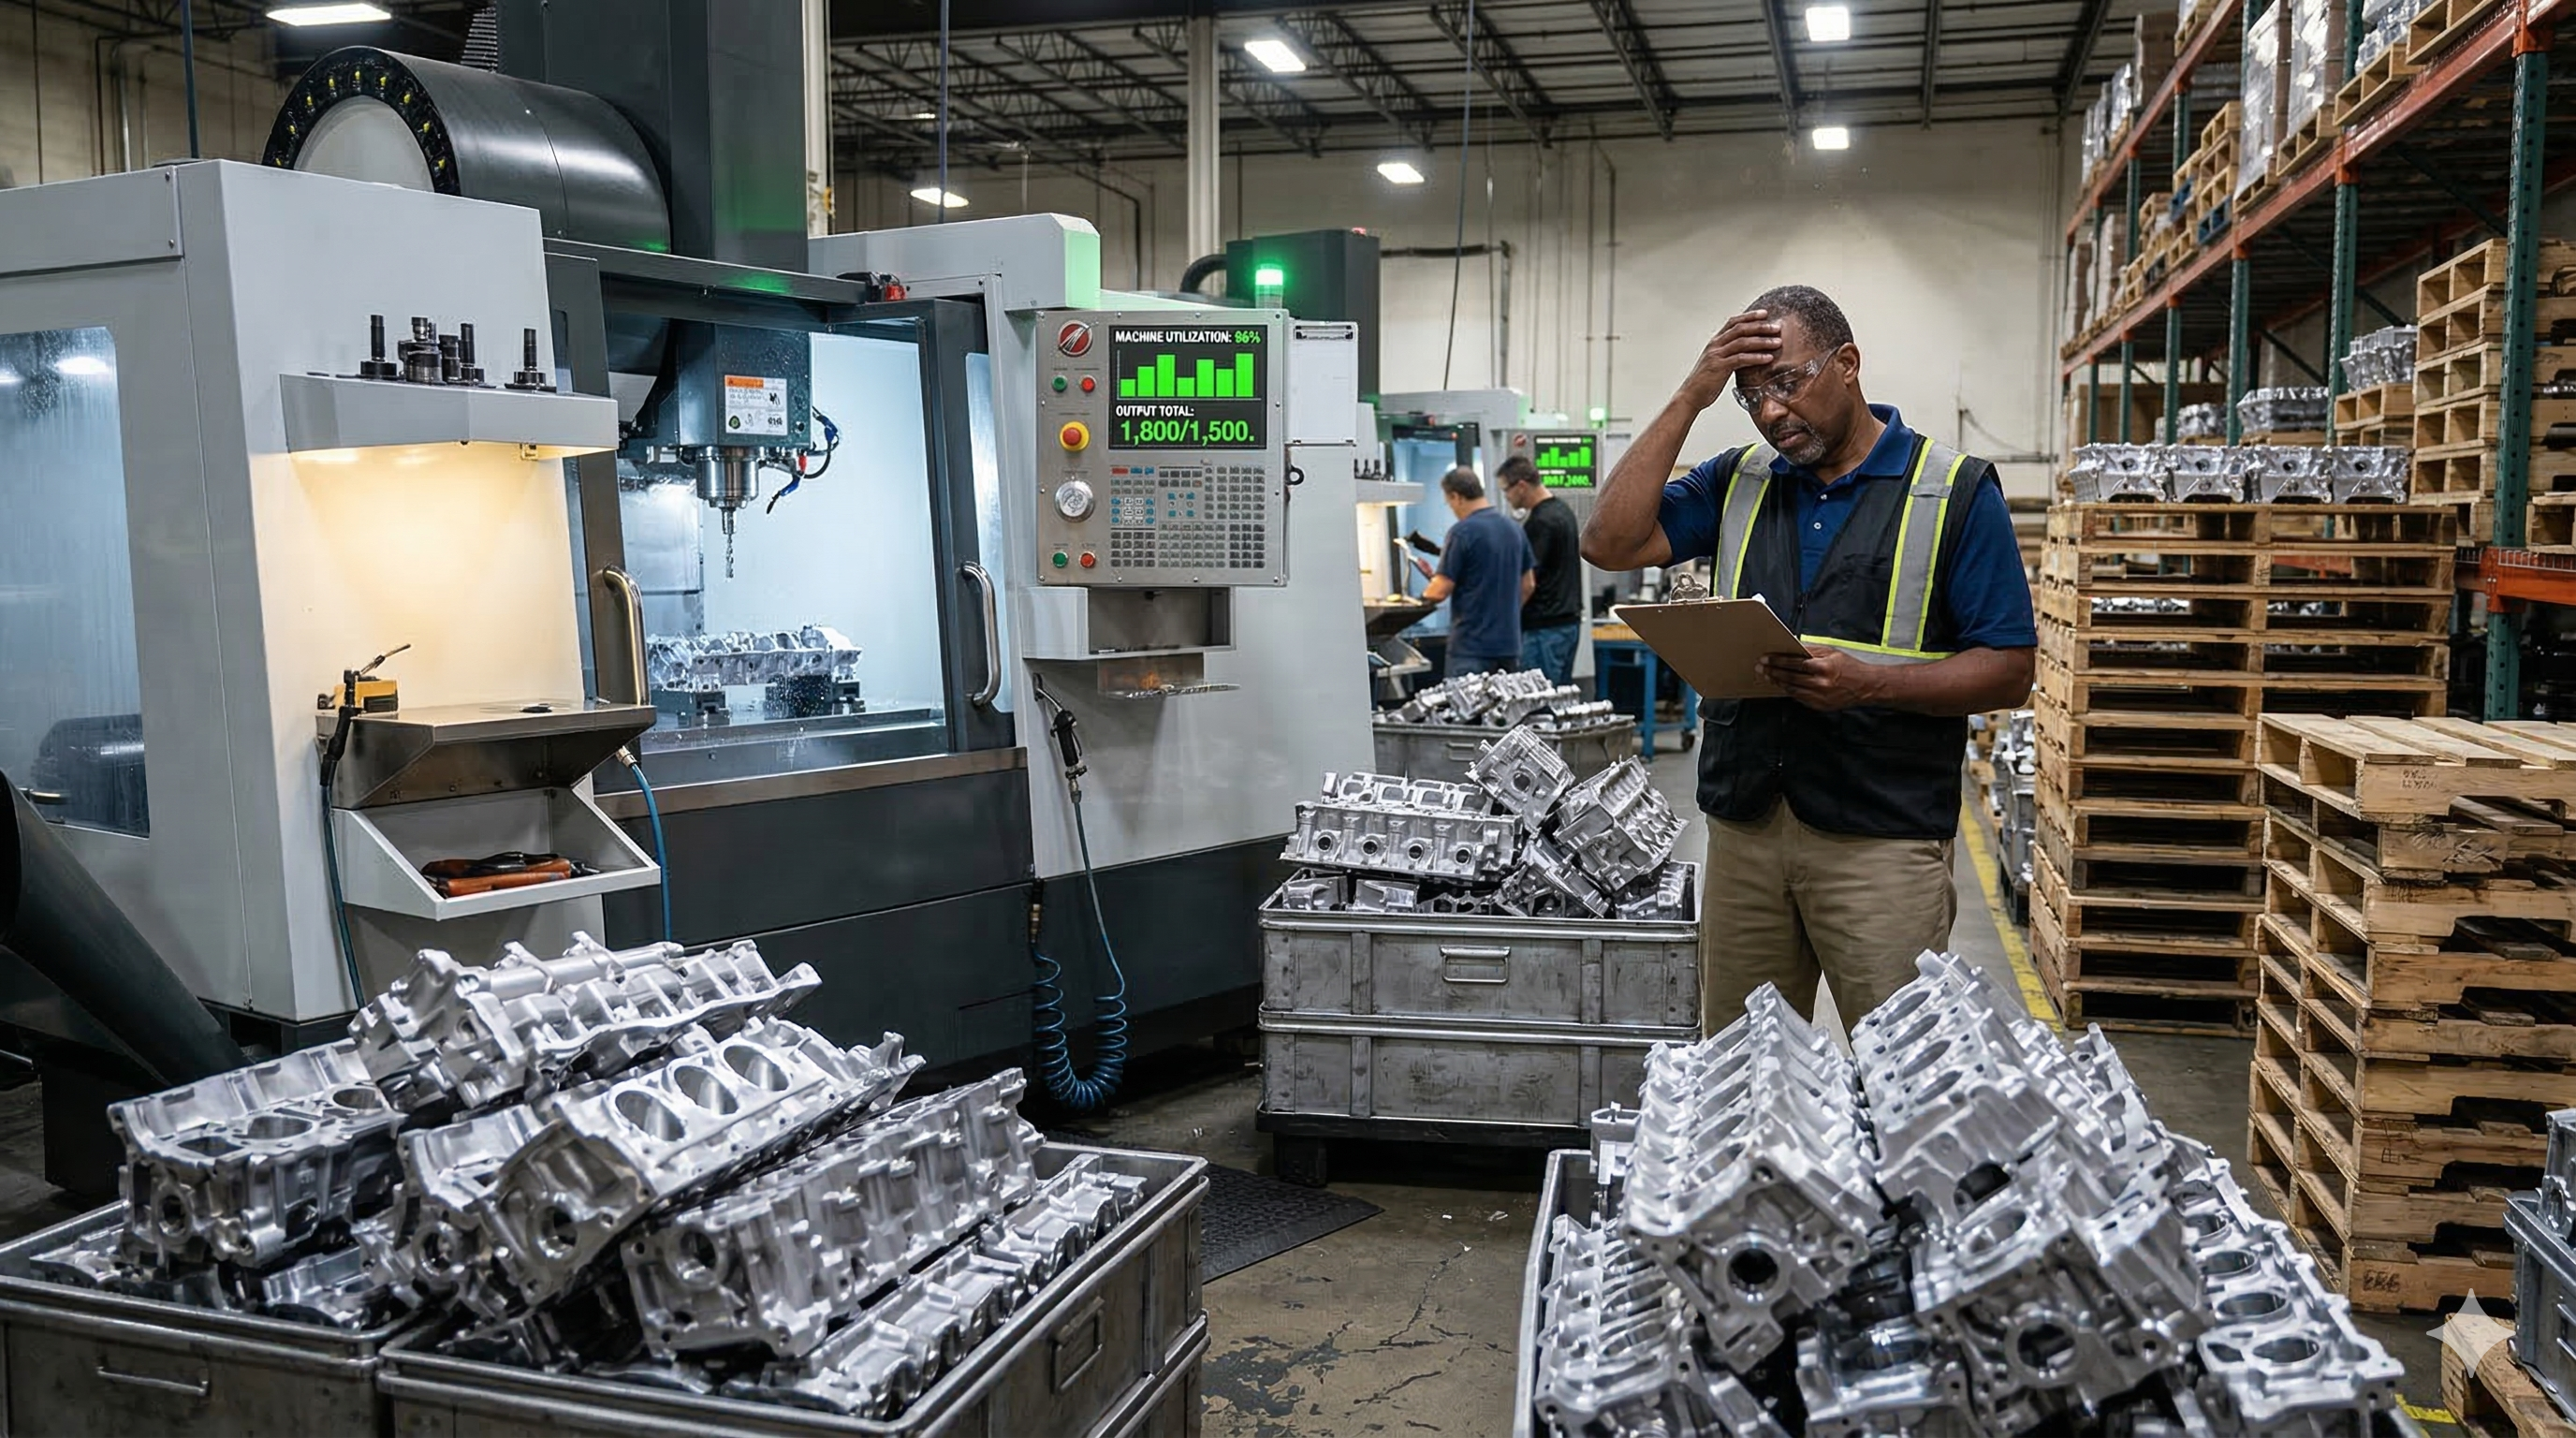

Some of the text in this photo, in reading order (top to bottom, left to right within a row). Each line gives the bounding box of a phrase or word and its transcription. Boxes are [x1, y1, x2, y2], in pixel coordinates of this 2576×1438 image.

[1115, 330, 1164, 343] MACHINE
[1165, 330, 1232, 344] UTILIZATION:
[1159, 405, 1194, 417] TOTAL:
[1120, 418, 1254, 446] 1,800/1,500.
